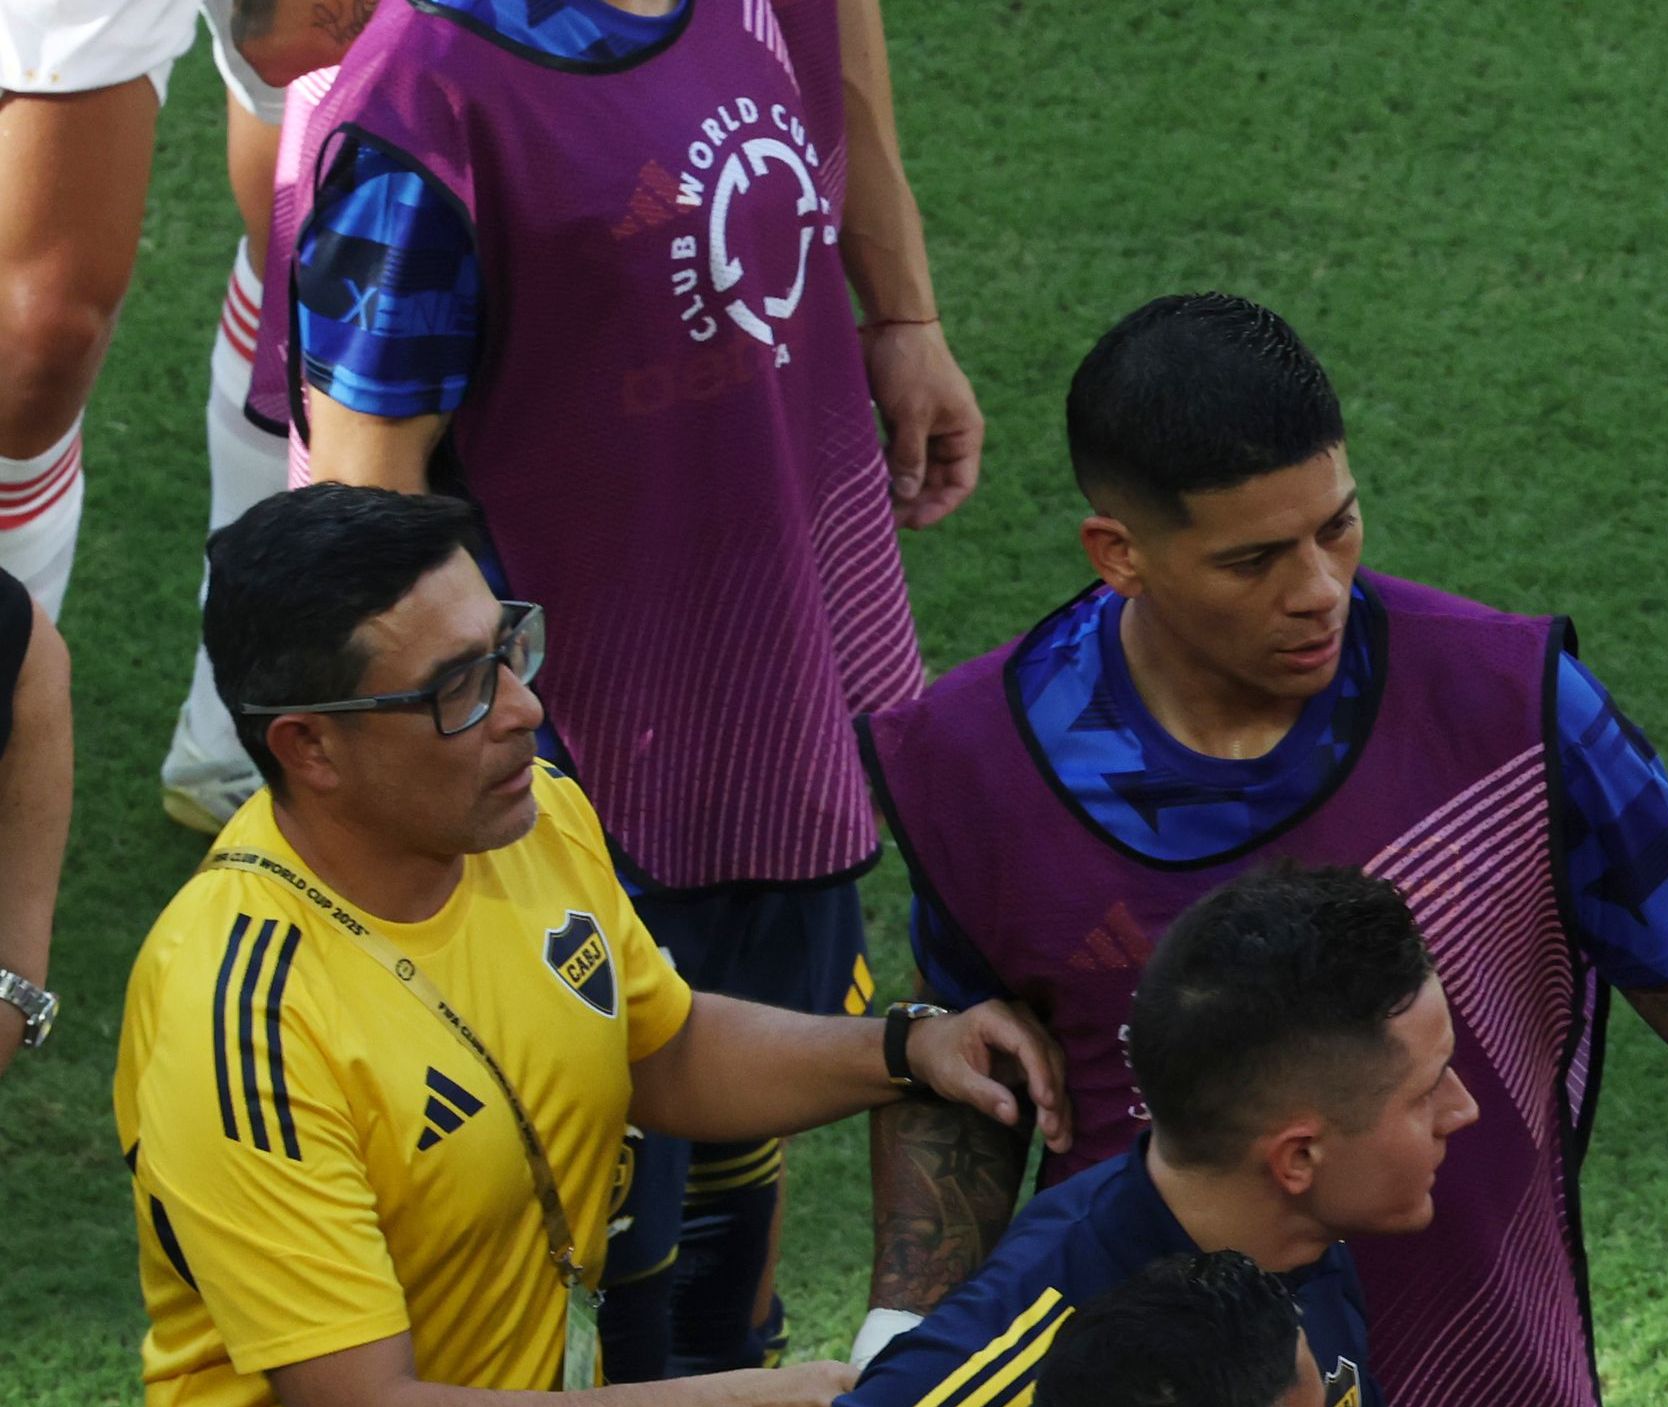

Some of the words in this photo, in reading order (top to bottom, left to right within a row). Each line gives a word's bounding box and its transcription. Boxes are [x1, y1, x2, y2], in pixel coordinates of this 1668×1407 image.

[676, 97, 758, 206] WORLD
[771, 104, 819, 167] CUP
[671, 235, 717, 341] CLUB
[259, 858, 307, 890] WORLD
[306, 888, 333, 909] CUP
[331, 907, 364, 936] 2025
[566, 940, 601, 983] CABJ
